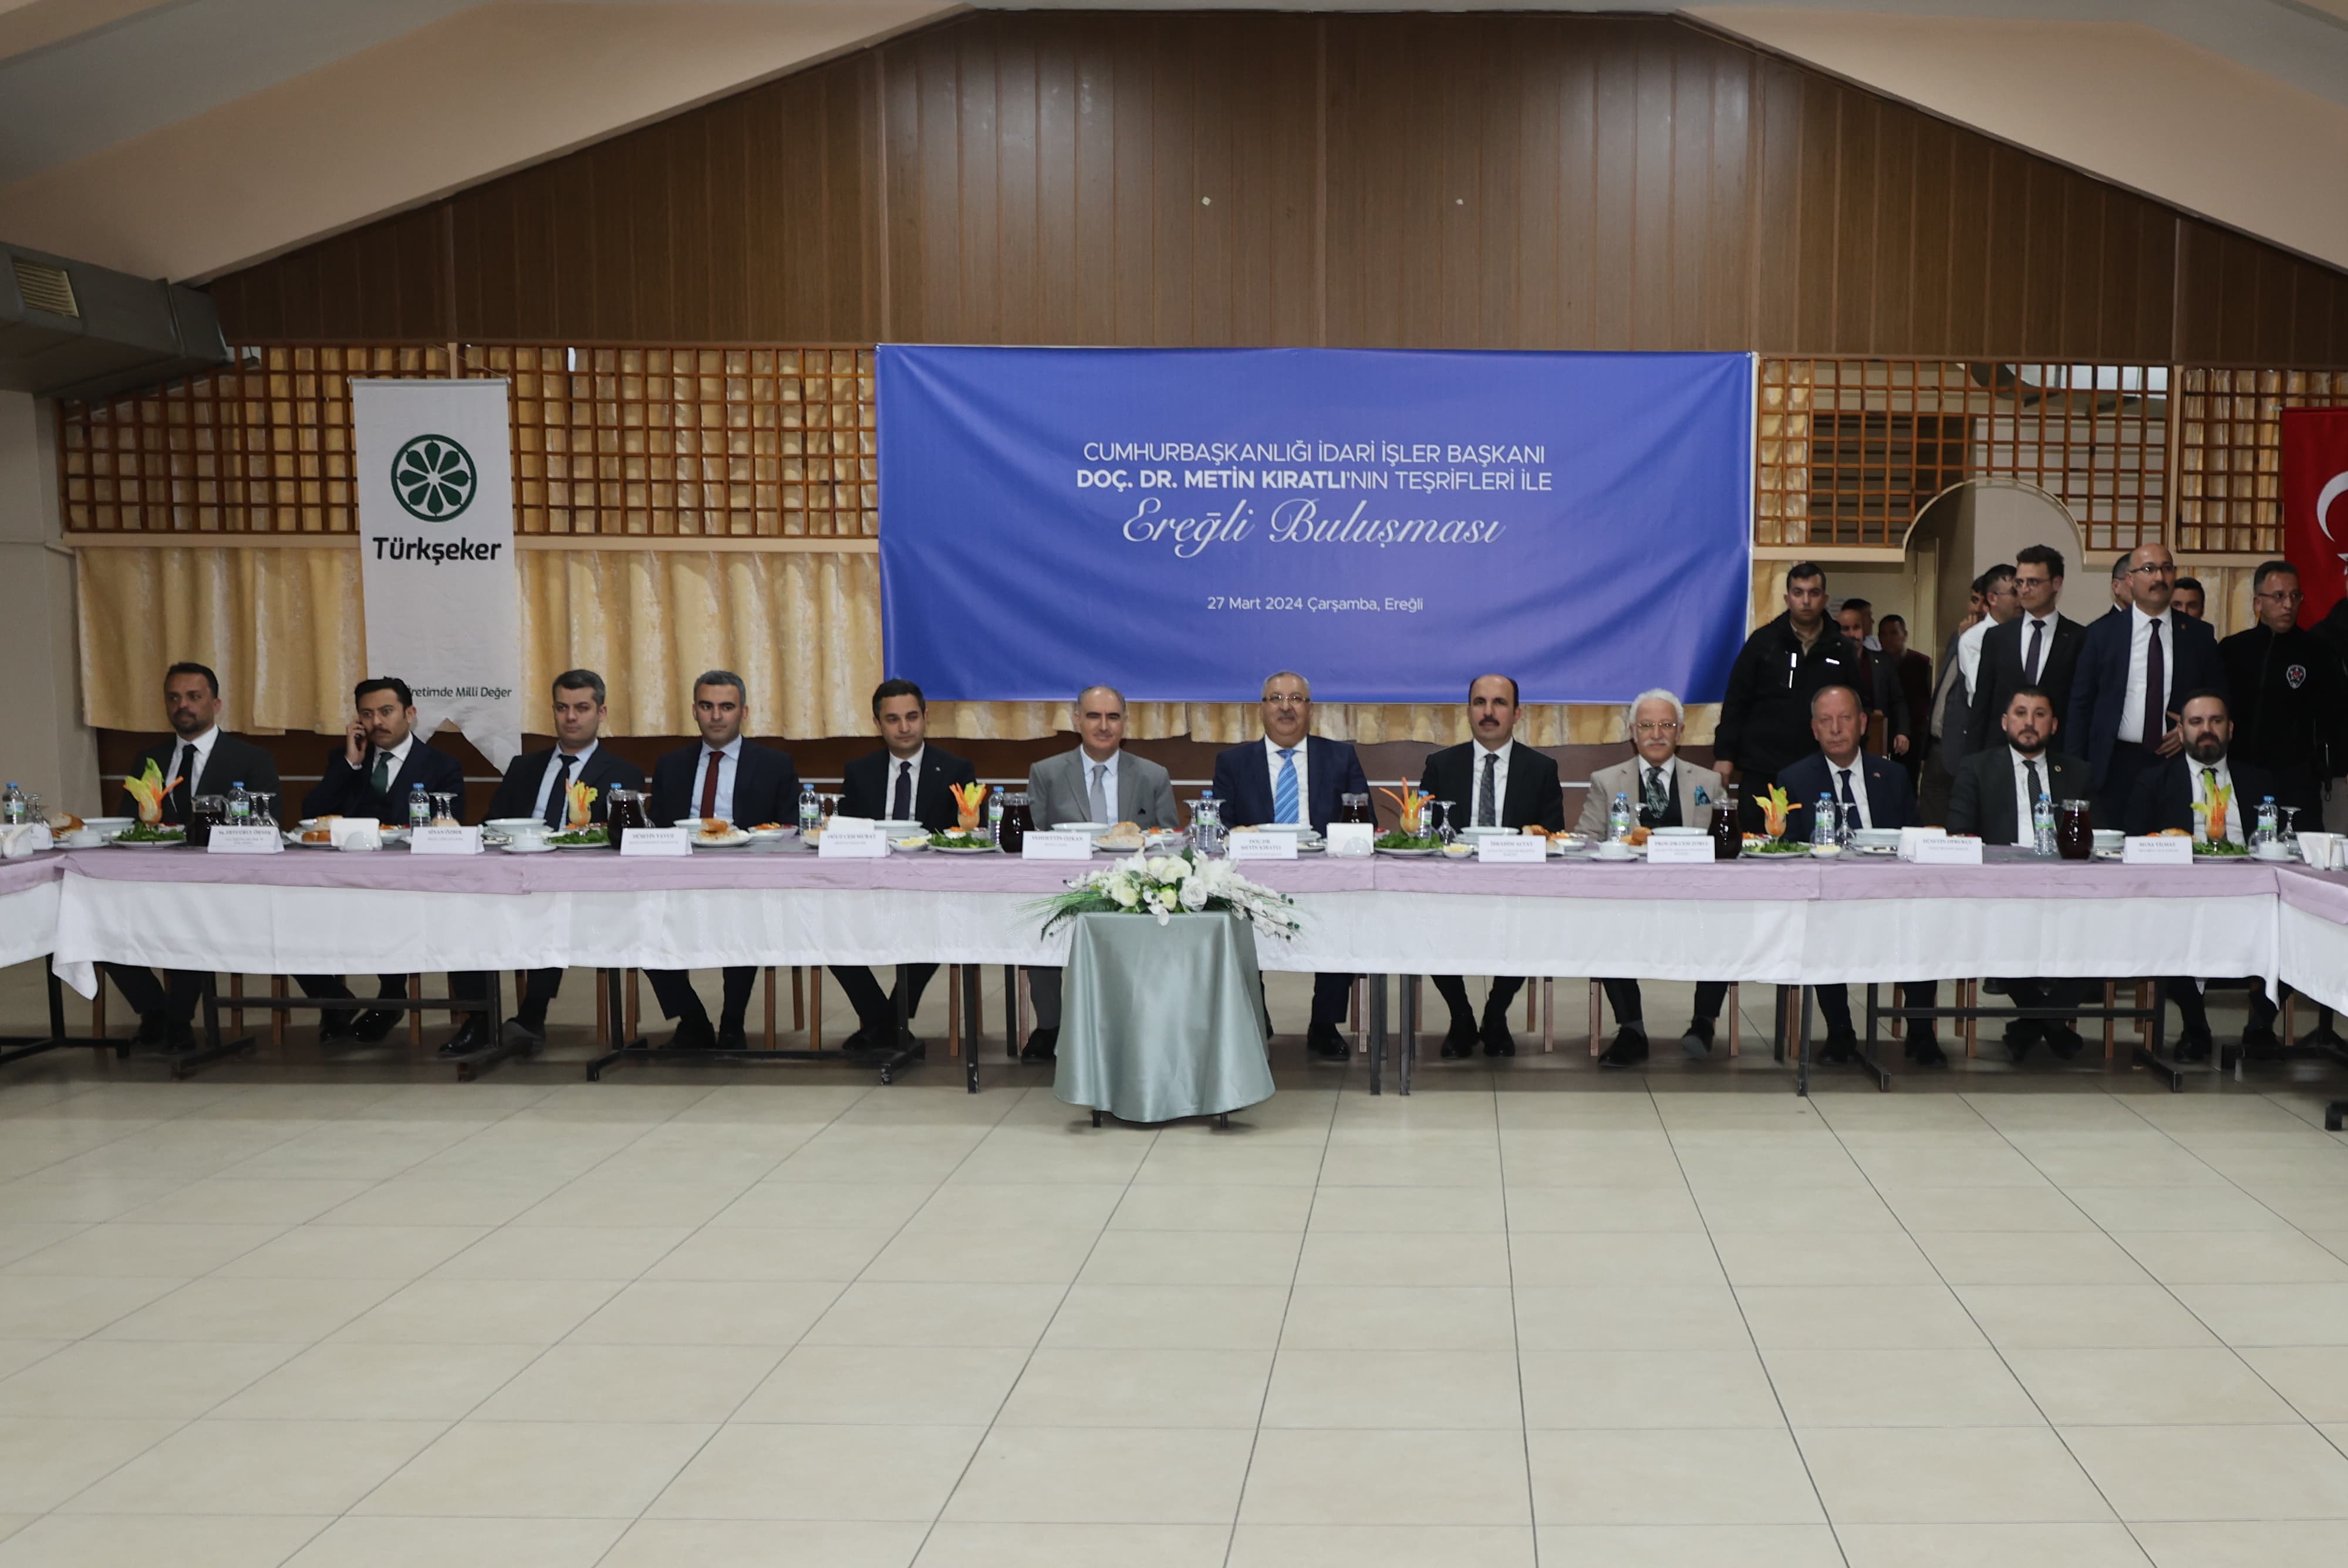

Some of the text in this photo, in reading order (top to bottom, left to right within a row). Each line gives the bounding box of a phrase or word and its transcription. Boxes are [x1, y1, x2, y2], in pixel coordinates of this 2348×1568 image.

[1084, 440, 1545, 467] CUMHURBAŞKANLIĞI İDARİ İŞLER BAŞKANI
[1077, 465, 1553, 494] DOÇ. DR. METİN KIRATLI'NIN TEŞRİFLERİ İLE
[1122, 496, 1507, 558] Ereğli Buluşması
[372, 536, 502, 566] Türkşeker
[1207, 596, 1423, 613] 27 Mart 2024 Çarşamba, Ereğli
[407, 685, 512, 700] retimde Milli Değer
